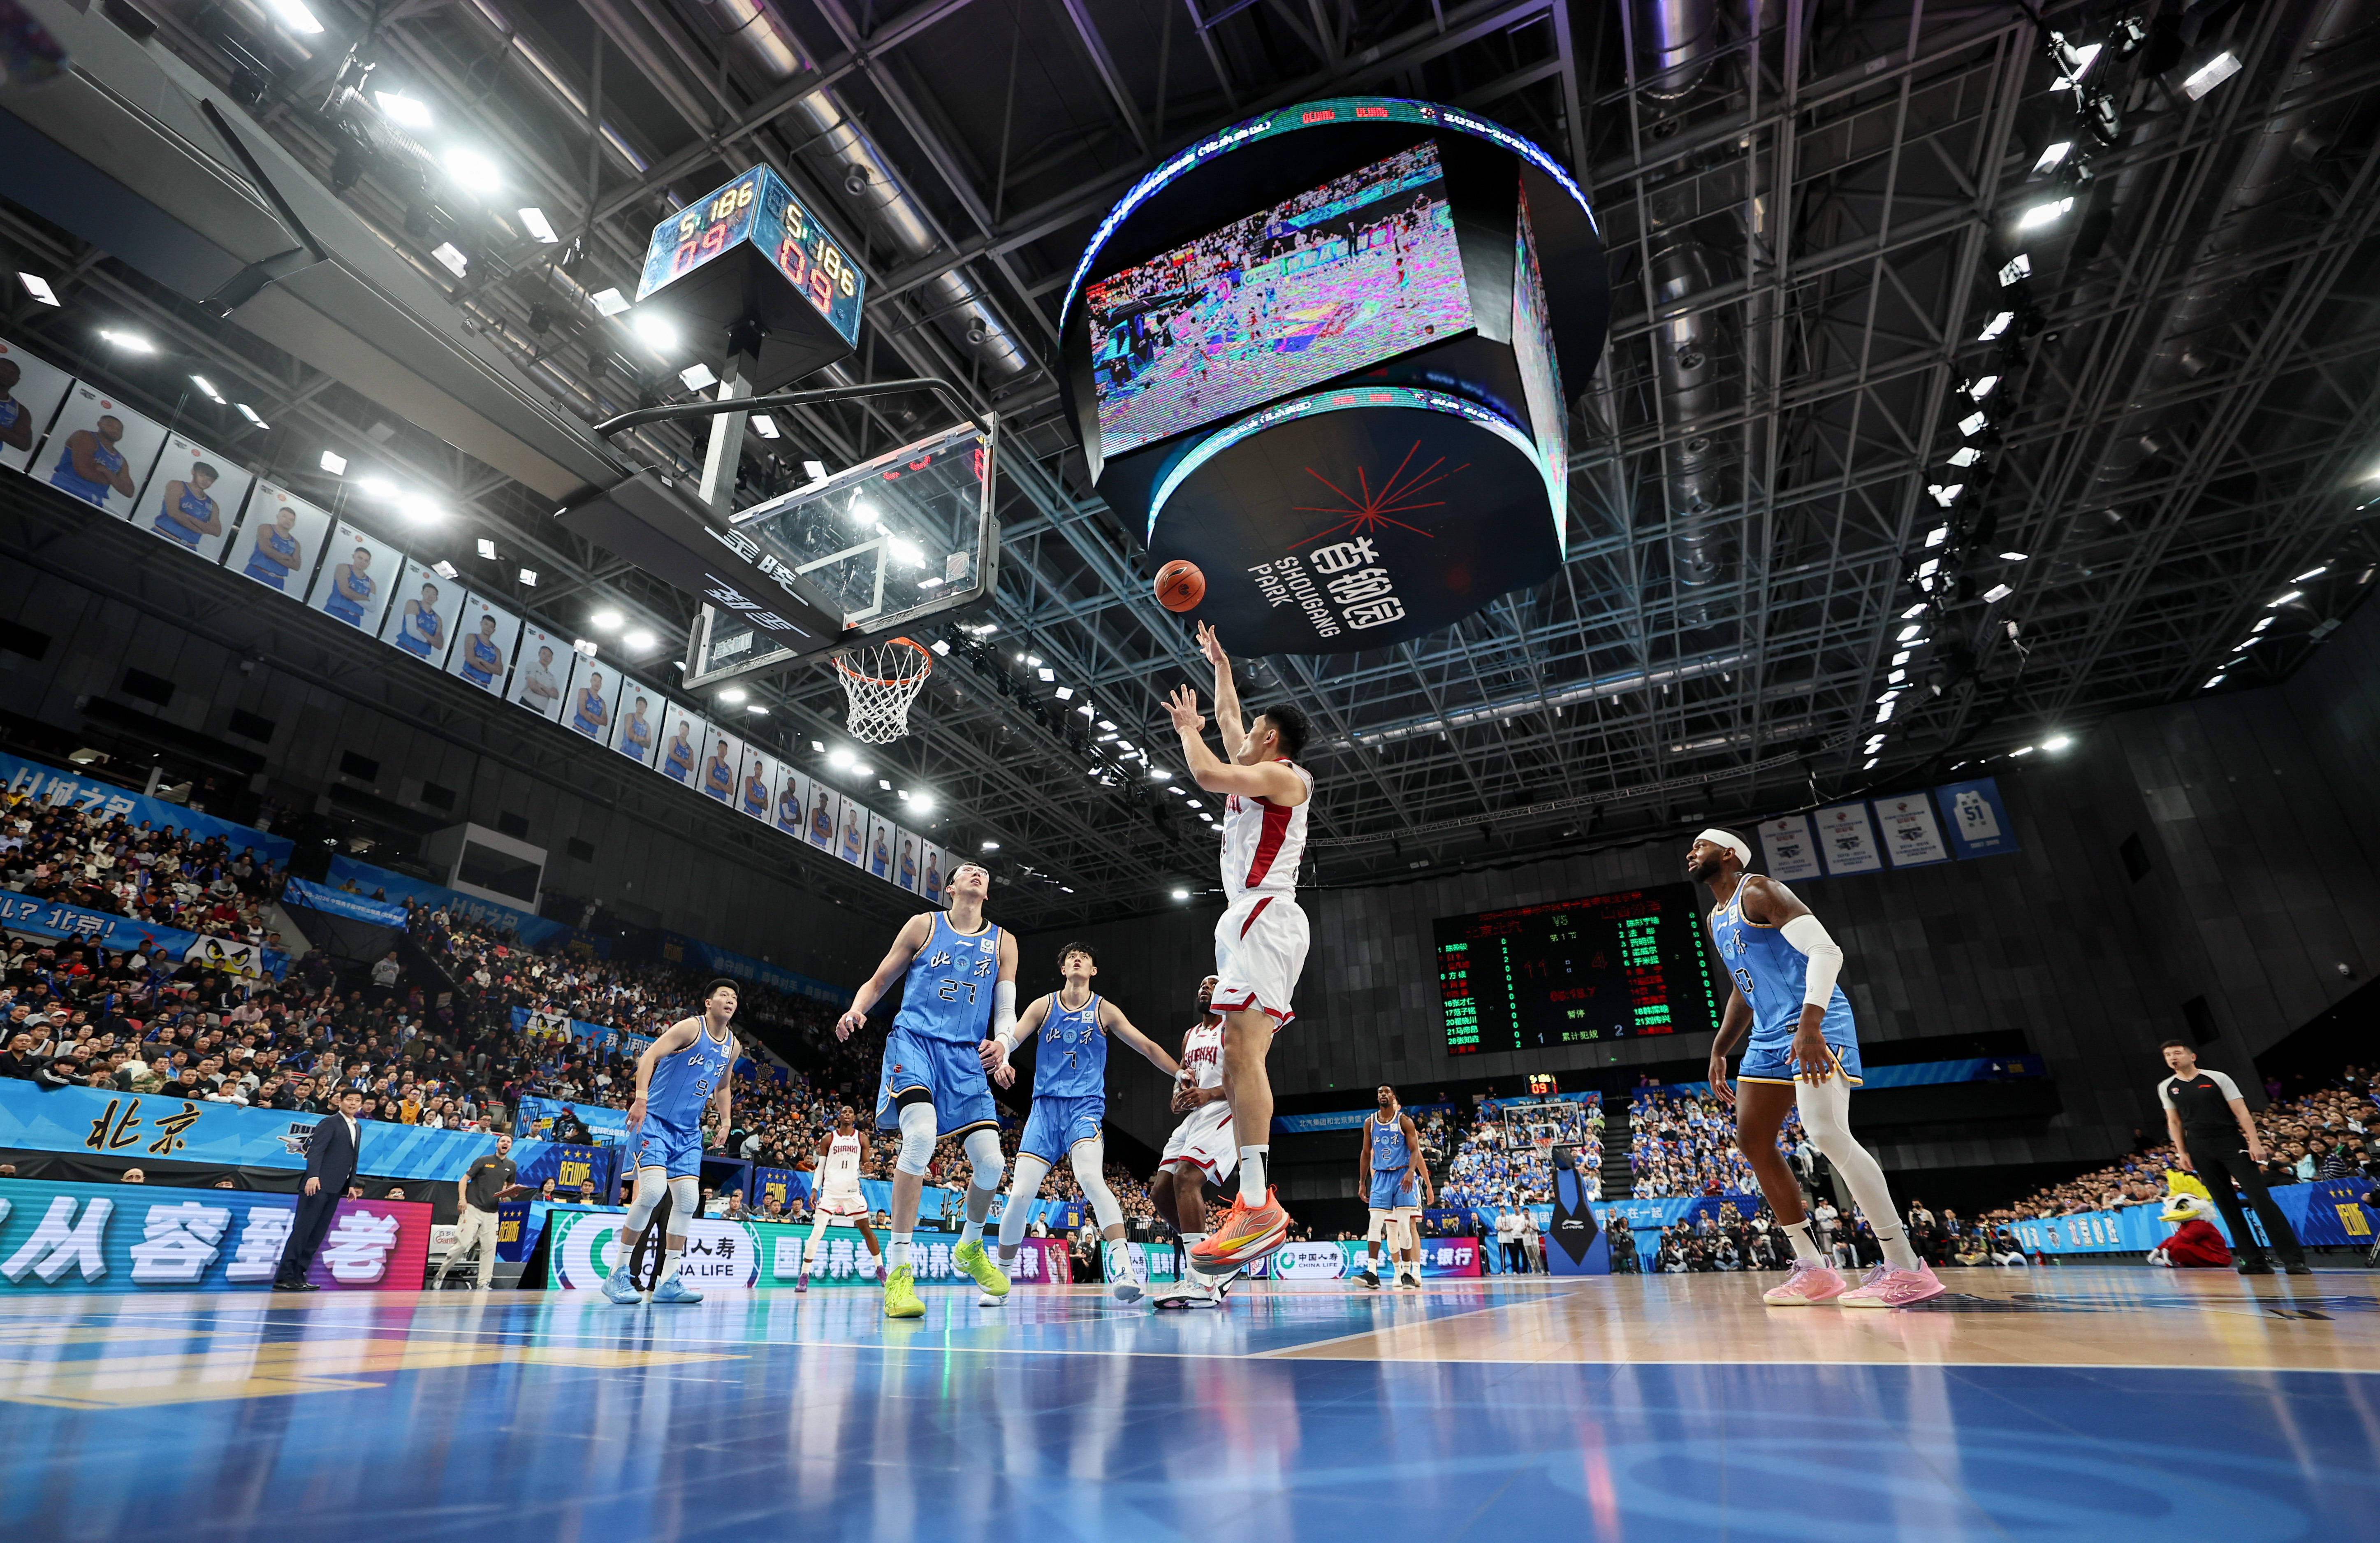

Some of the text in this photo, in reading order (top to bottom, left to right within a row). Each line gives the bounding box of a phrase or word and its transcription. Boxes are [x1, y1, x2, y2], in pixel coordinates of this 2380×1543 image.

[670, 223, 727, 275] 09
[780, 238, 833, 314] 09
[704, 526, 809, 607] 金陵
[1247, 563, 1293, 608] PARK
[1309, 536, 1405, 629] 首钢园
[1275, 556, 1340, 638] SHOUGANG
[1963, 805, 1984, 821] 51
[1552, 915, 1569, 926] VS
[1735, 967, 1754, 993] 0
[939, 979, 977, 1005] 27
[1567, 1009, 1585, 1019] 暂停
[1538, 1033, 1543, 1044] 1
[1562, 1029, 1599, 1042] 累计犯规
[1614, 1024, 1624, 1036] 2
[1063, 1051, 1077, 1070] 7
[693, 1079, 708, 1097] 9
[1531, 1083, 1548, 1094] 09
[86, 1097, 202, 1155] 北京
[1300, 1115, 1362, 1128] 北汽集团和北京男篮
[833, 1145, 858, 1155] SHANXI
[1381, 1148, 1391, 1160] 2
[558, 1161, 591, 1186] BEIJING
[841, 1160, 848, 1169] 11
[765, 1182, 786, 1204] BEIJING
[1627, 1206, 1664, 1220] 在一起
[498, 1220, 521, 1242] BEIJING
[646, 1233, 735, 1260] 中人寿
[1299, 1253, 1338, 1262] 中国人寿
[702, 1265, 733, 1276] LIFE
